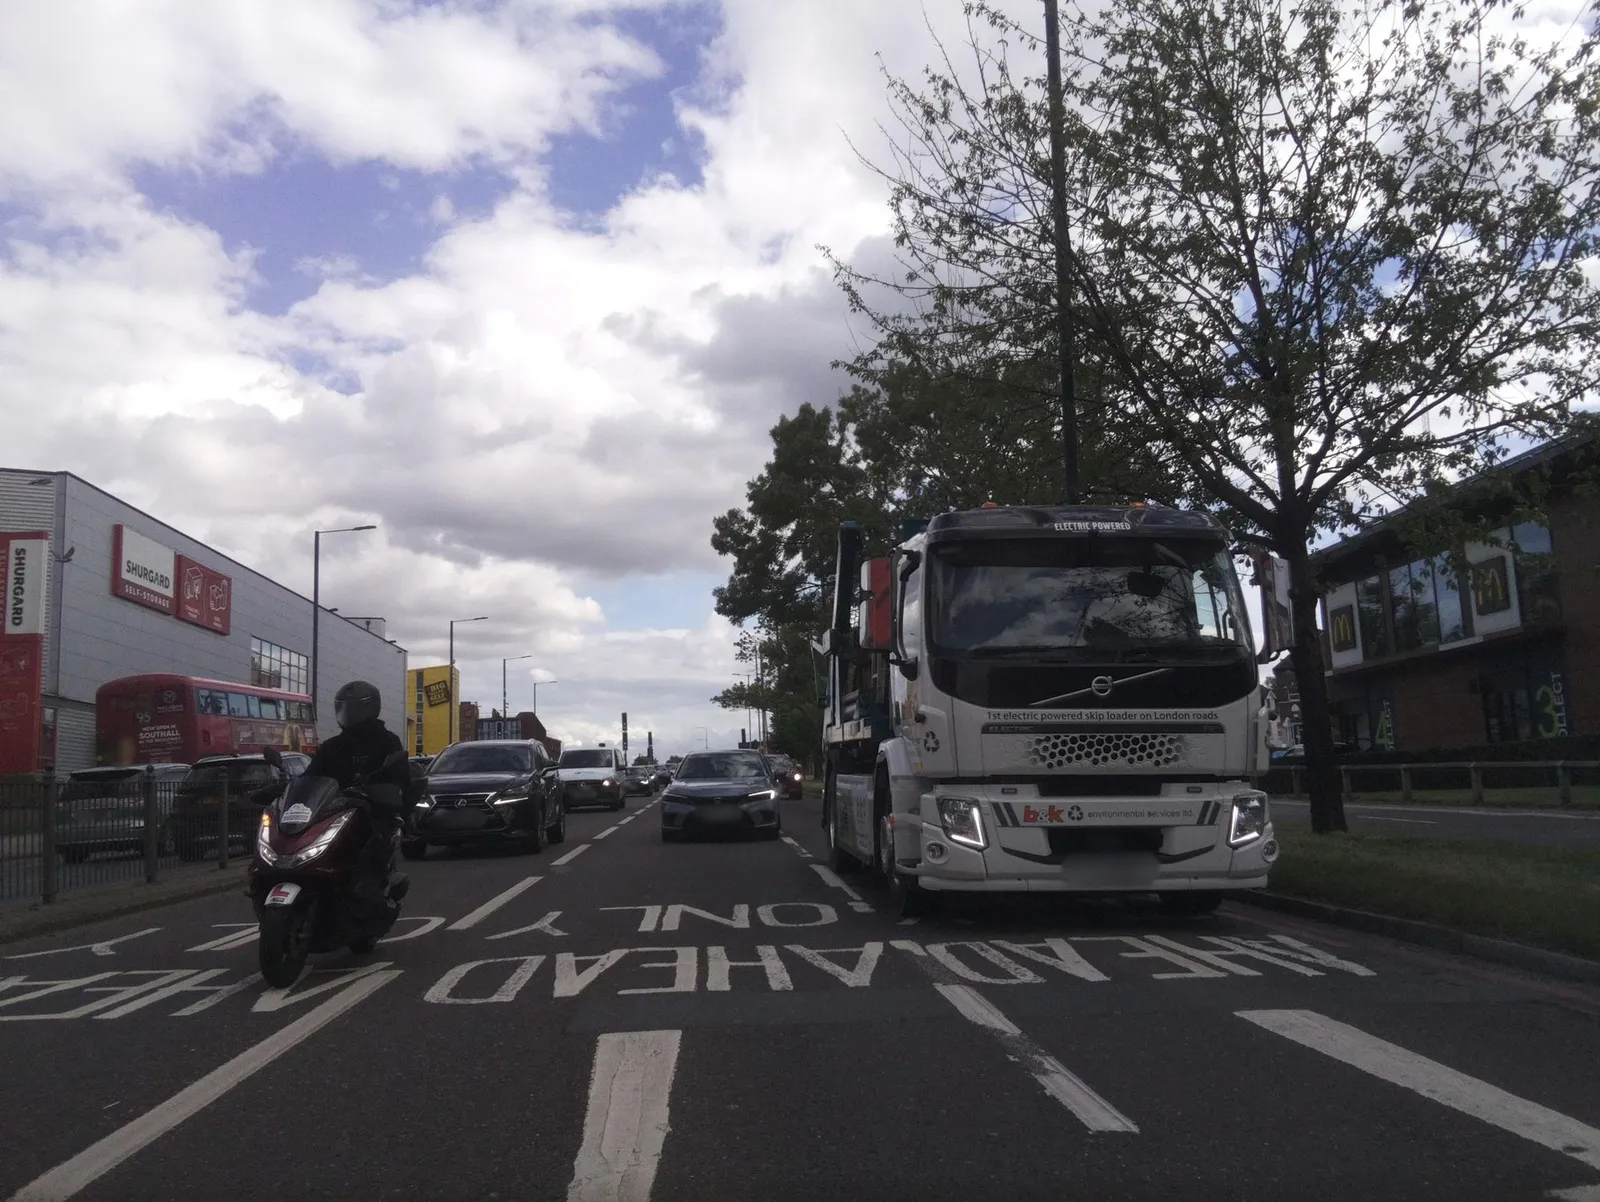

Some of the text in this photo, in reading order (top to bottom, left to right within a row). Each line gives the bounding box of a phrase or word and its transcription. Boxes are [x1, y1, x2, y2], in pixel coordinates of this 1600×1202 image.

[1054, 521, 1131, 531] ELECTRIC POWERED
[126, 559, 170, 589] SHURGARD
[11, 547, 26, 627] SHURGARD
[125, 584, 170, 608] SELF-STORAGE
[1551, 671, 1569, 738] OLLECT
[136, 711, 151, 723] 95
[987, 711, 1000, 720] 1st
[1003, 711, 1037, 720] electric
[1040, 711, 1083, 722] powered
[1086, 711, 1105, 722] skip
[1106, 711, 1137, 720] loader
[1154, 711, 1190, 720] London
[1192, 711, 1219, 720] roads
[139, 729, 181, 740] SOUTHALL
[1023, 805, 1065, 823] b&k
[1088, 808, 1145, 818] environmental
[423, 941, 884, 1005] AHEAD
